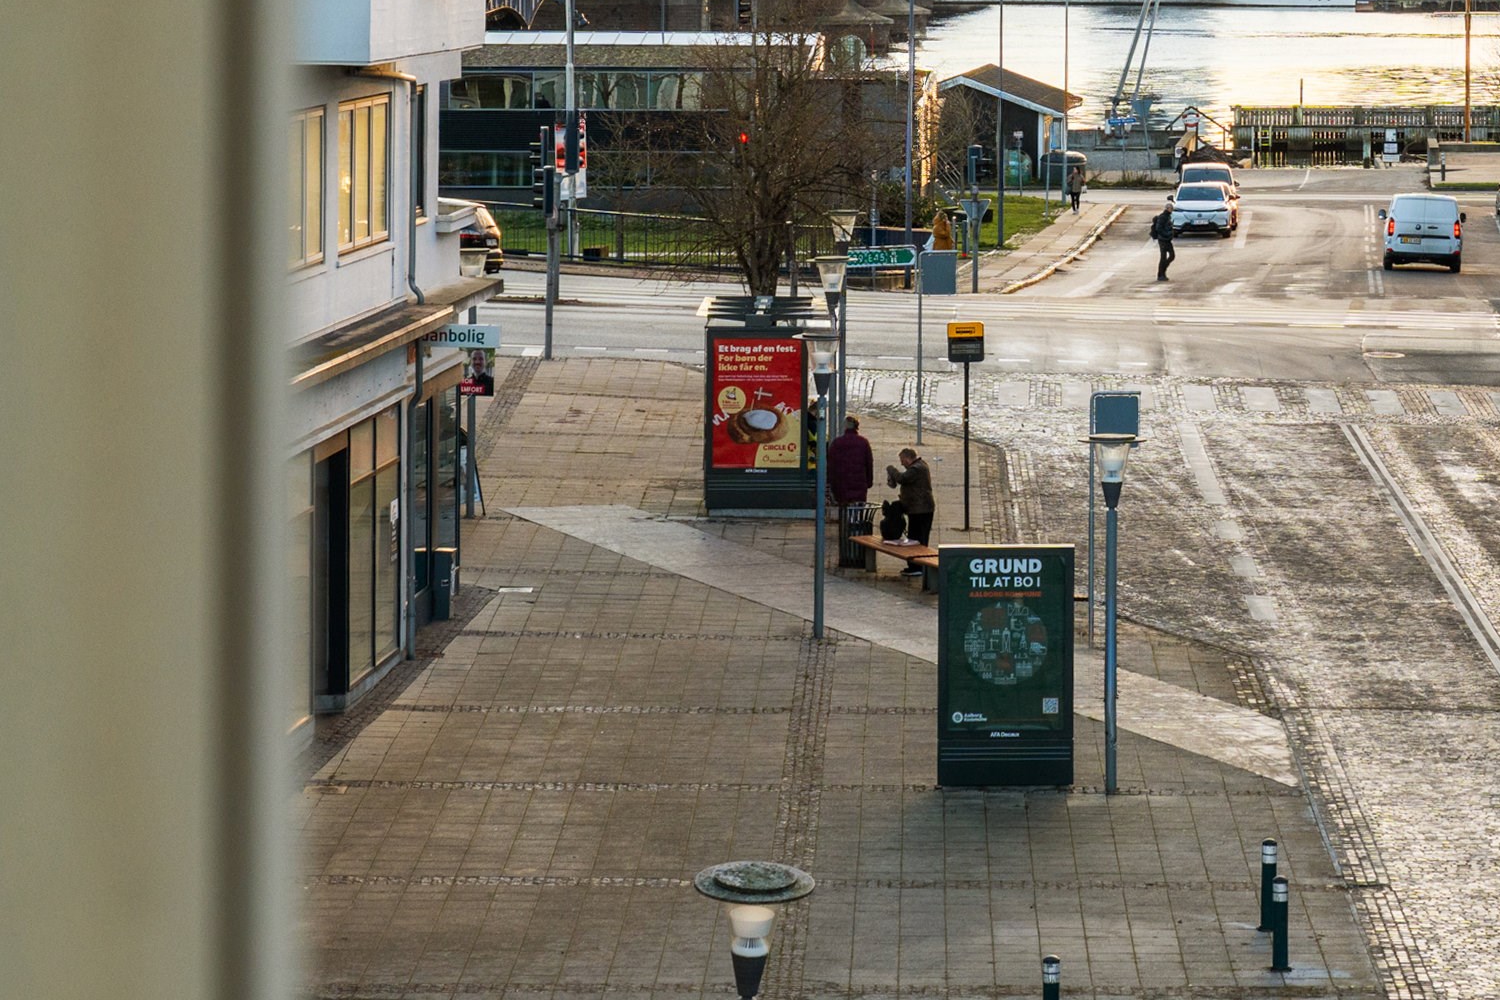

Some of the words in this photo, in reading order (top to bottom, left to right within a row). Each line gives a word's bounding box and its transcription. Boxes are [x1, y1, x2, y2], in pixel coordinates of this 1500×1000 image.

[730, 345, 751, 354] brag
[718, 363, 738, 371] ikke
[740, 362, 753, 371] får
[969, 558, 1042, 574] GRUND
[969, 577, 990, 587] TIL
[993, 577, 1011, 587] AT
[1014, 576, 1033, 588] BO
[1036, 577, 1040, 587] I
